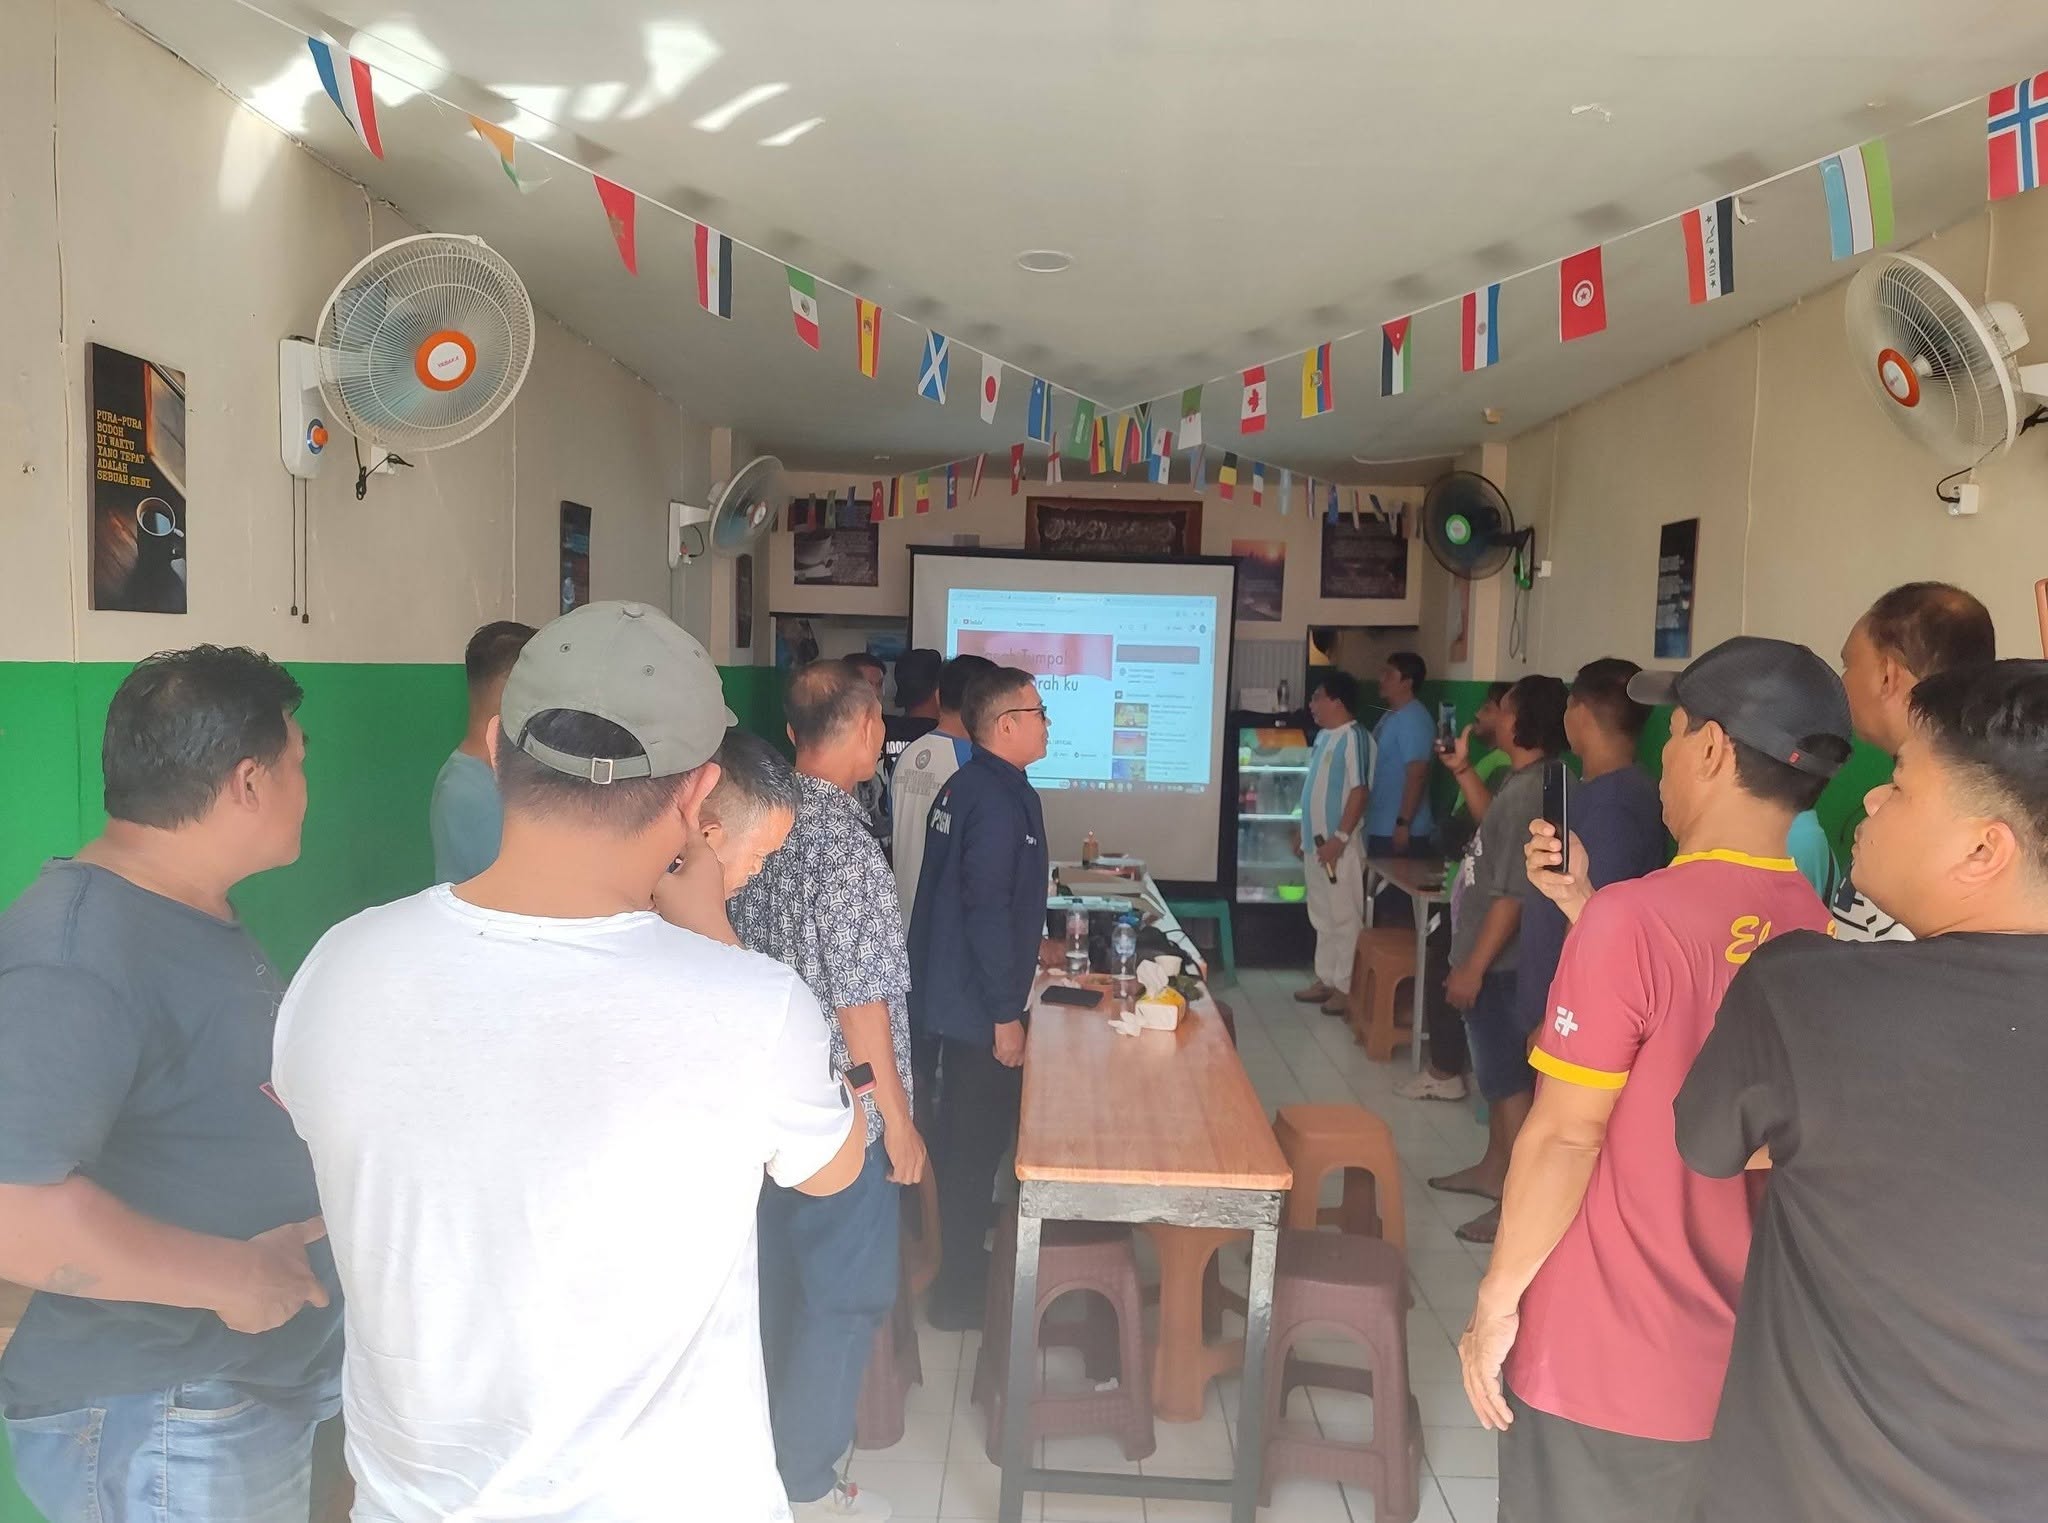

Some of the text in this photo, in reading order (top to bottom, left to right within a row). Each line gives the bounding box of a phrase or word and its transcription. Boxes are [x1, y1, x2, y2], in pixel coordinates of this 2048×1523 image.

[96, 409, 142, 430] PURA-PURA
[96, 421, 124, 437] BODOH
[96, 433, 135, 451] DI WAKTU
[120, 450, 145, 464] TEPAT
[97, 458, 128, 473] ADALAH
[96, 469, 129, 485] SEBUAH
[1064, 675, 1079, 692] ku
